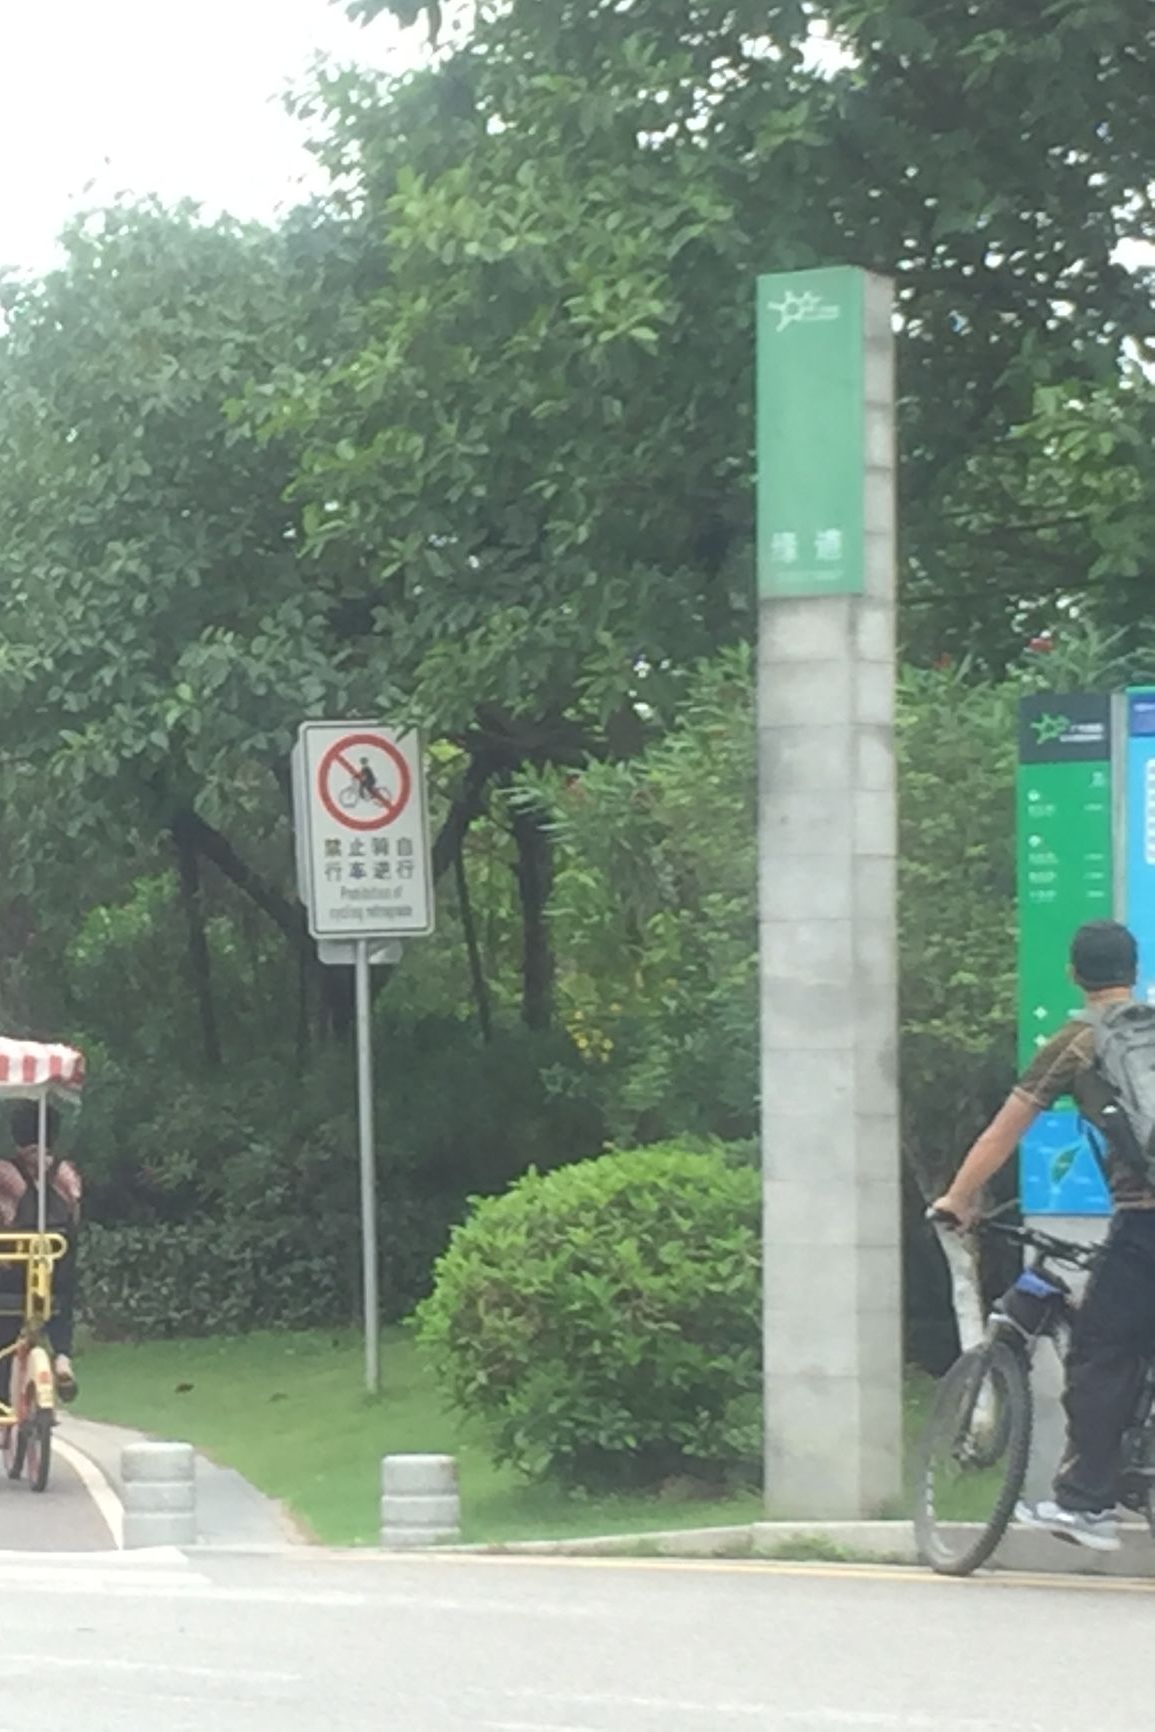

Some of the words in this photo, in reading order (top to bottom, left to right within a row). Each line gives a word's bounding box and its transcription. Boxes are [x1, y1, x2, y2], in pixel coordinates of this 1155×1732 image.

[325, 837, 413, 856] 禁止骑自
[325, 861, 414, 881] 行车逆行
